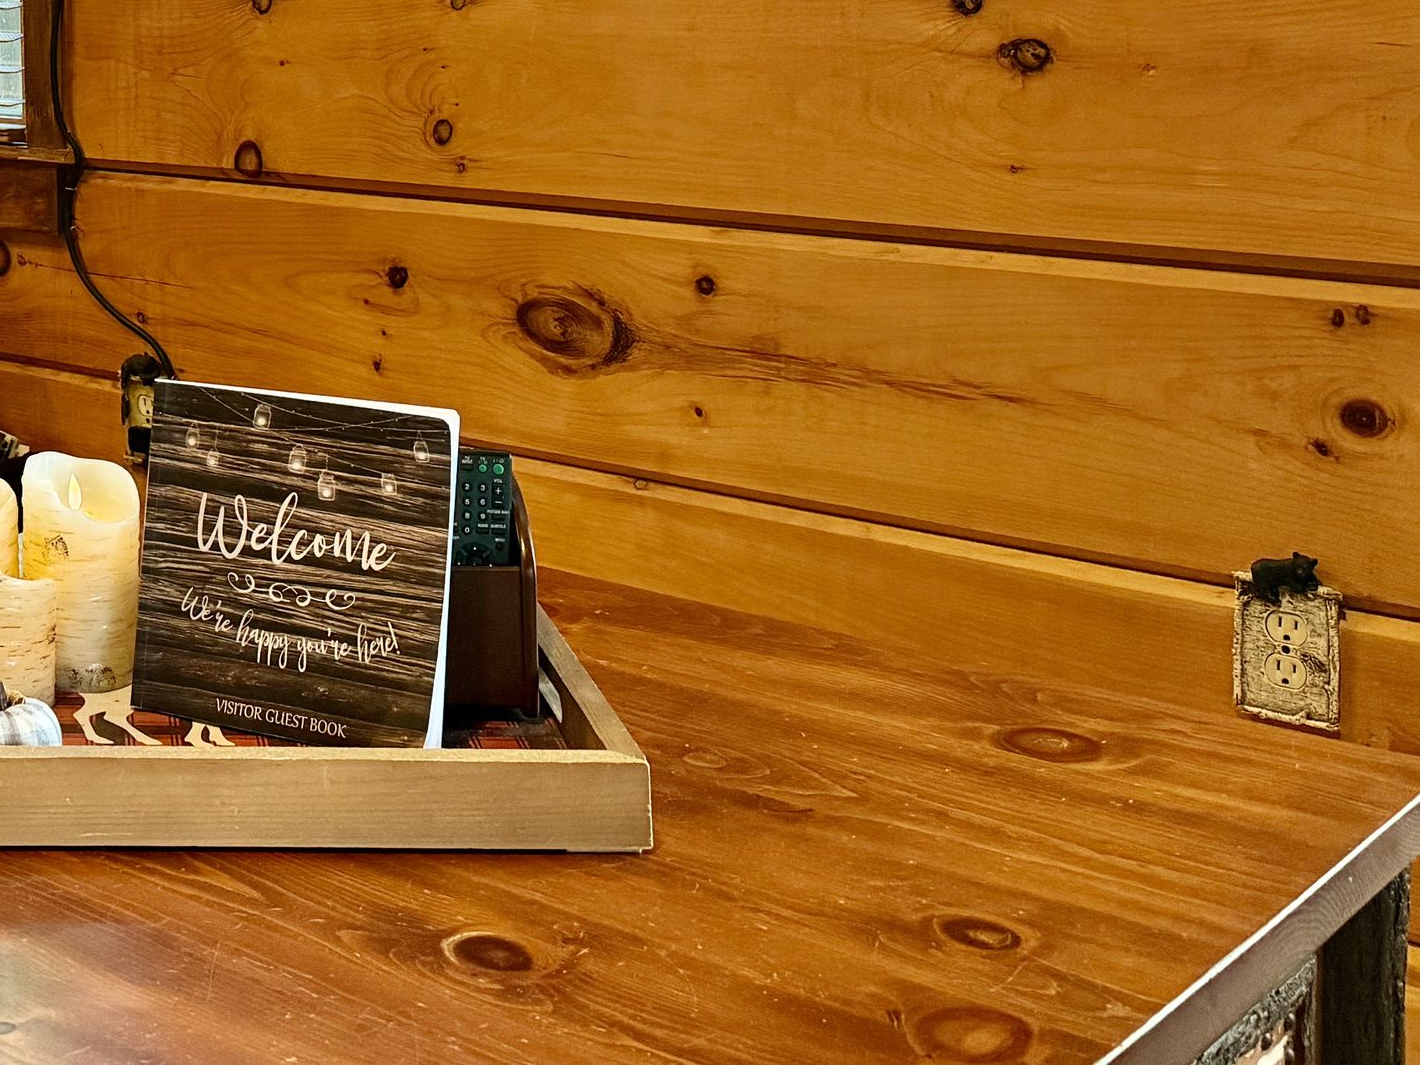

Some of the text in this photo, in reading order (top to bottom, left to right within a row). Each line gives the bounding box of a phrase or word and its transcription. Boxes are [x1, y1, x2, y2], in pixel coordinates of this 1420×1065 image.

[480, 484, 486, 492] 3
[480, 498, 486, 506] 6
[197, 491, 396, 572] Welcome
[464, 526, 470, 534] 0
[181, 586, 401, 673] We're happy you're here!
[215, 698, 347, 739] VISITOR GUEST BOOK
